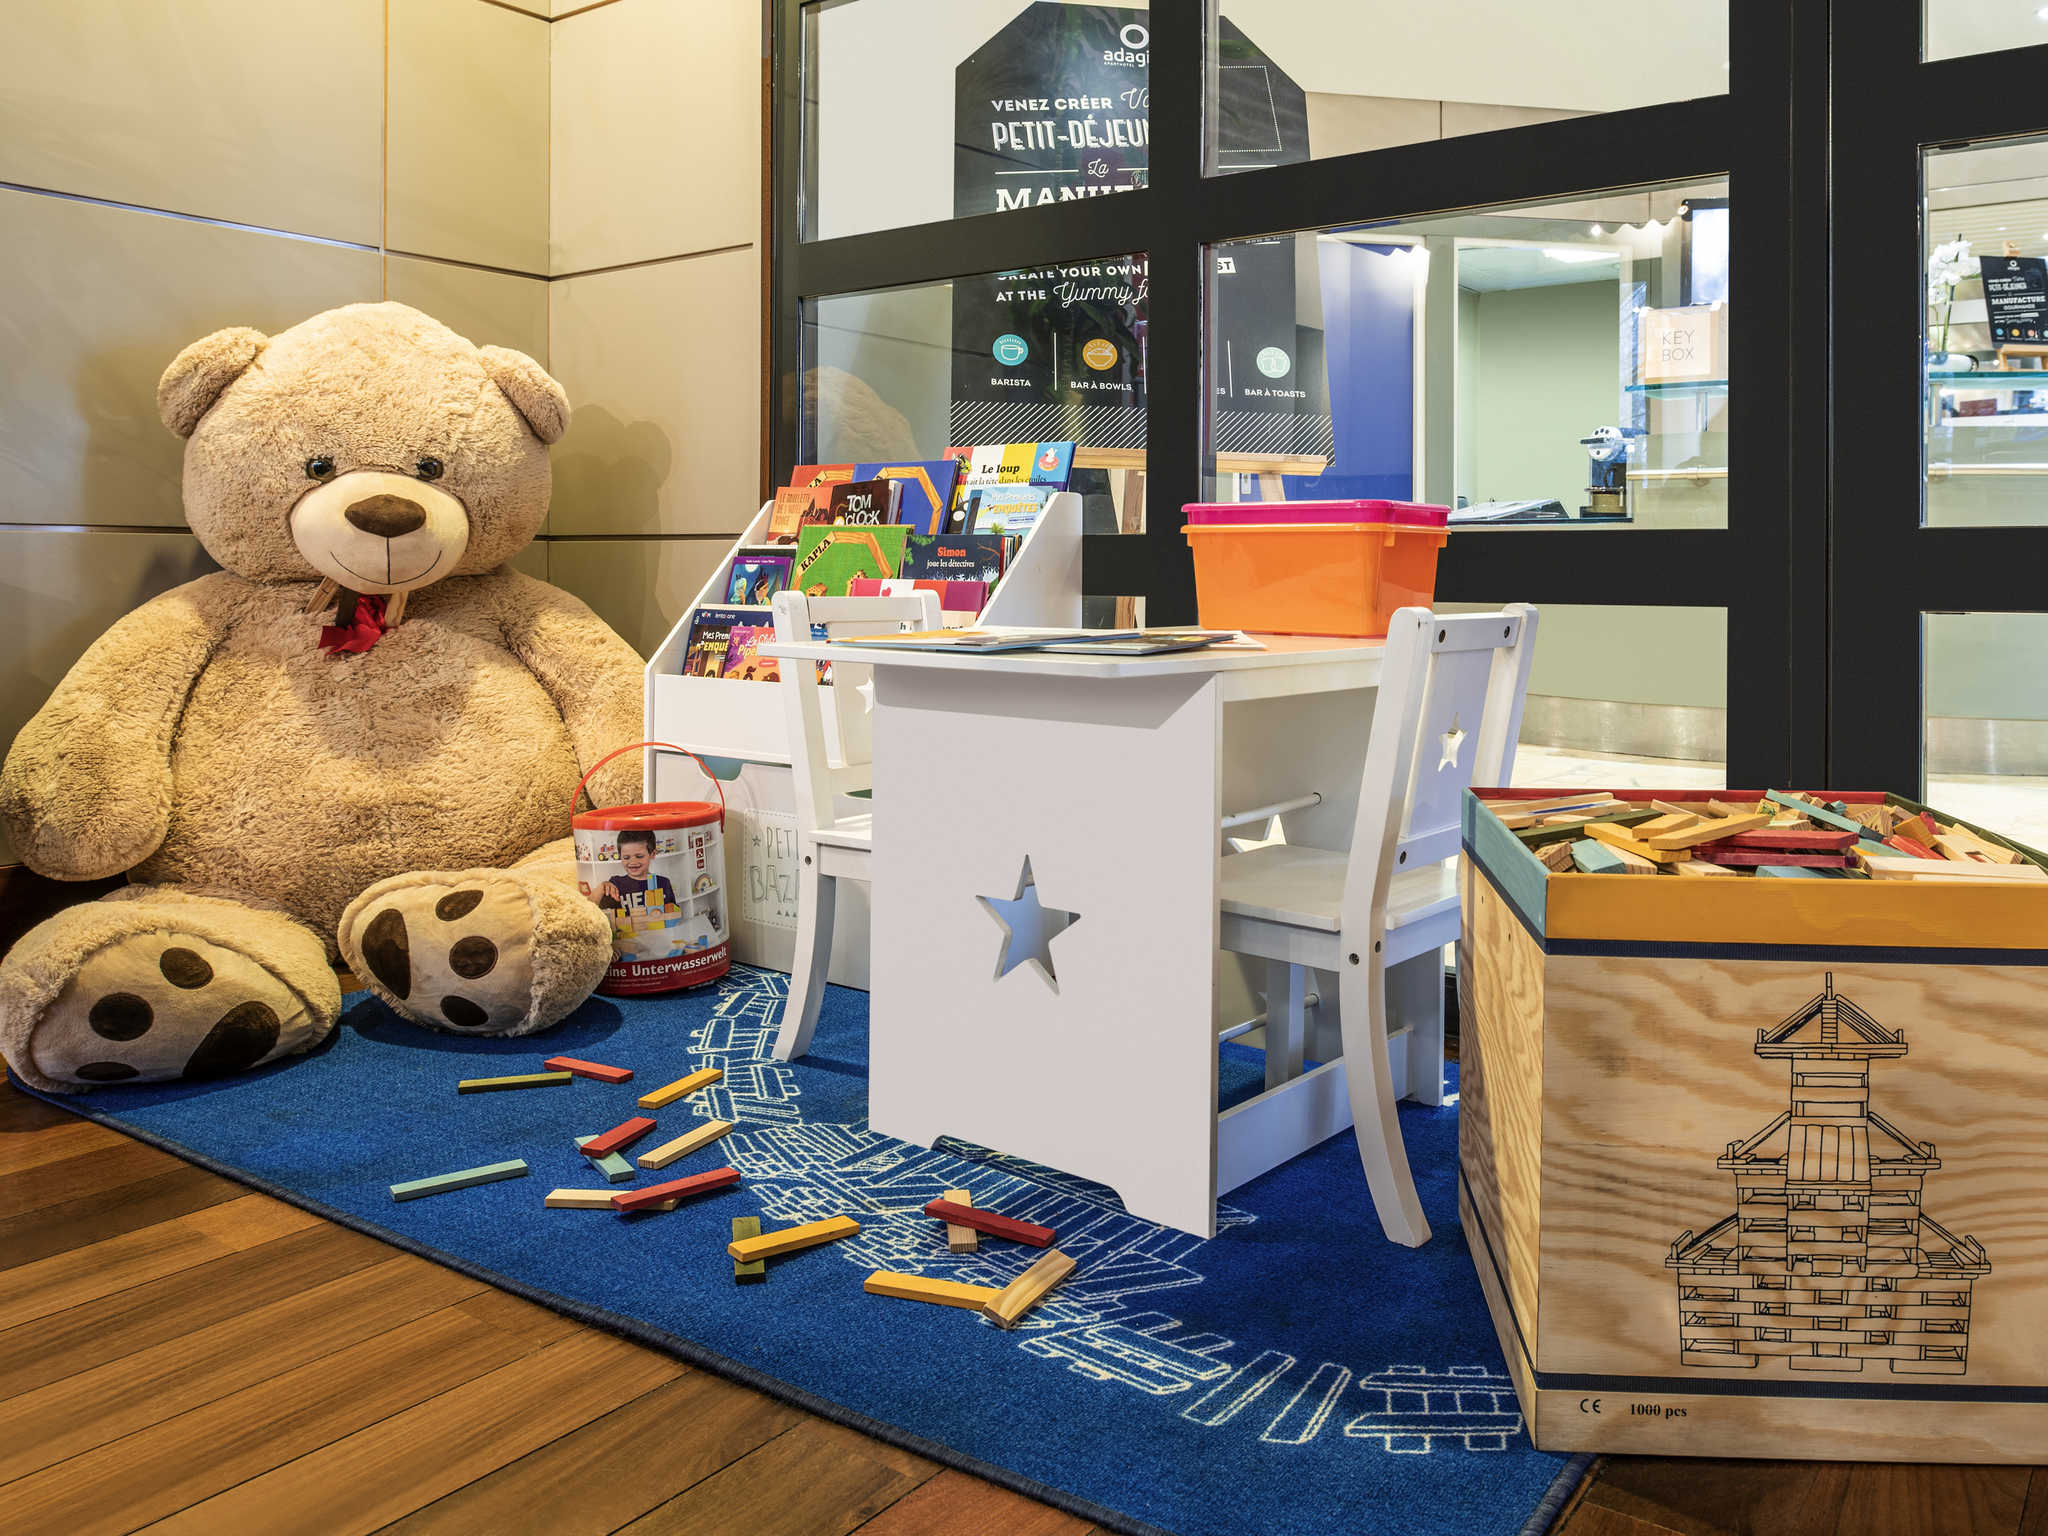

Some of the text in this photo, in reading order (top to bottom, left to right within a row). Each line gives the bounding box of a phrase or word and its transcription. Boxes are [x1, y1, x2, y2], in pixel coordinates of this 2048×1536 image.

[1104, 47, 1149, 67] adagi
[991, 99, 1049, 111] VENEZ
[1054, 95, 1113, 110] CRÉER
[1087, 158, 1109, 177] La
[1058, 266, 1101, 278] YOUR
[1106, 265, 1142, 276] OWN
[996, 291, 1014, 302] AT
[1017, 289, 1046, 300] THE
[1053, 281, 1133, 308] Yummy
[1992, 296, 2046, 305] MANUFACTURE
[1662, 329, 1695, 345] KEY
[1662, 347, 1694, 361] BOX
[991, 378, 1031, 387] BARISTA
[1070, 381, 1132, 391] BAR À BOWLS
[1244, 387, 1306, 398] BAR À TOASTS
[981, 464, 1020, 475] Le loup
[847, 494, 872, 512] TOM
[800, 538, 831, 571] KAPLA
[937, 546, 966, 557] Simon
[926, 559, 939, 569] joue
[948, 558, 975, 568] détectives
[737, 644, 758, 656] Pipe
[766, 826, 799, 860] PETI
[619, 891, 644, 910] HE
[631, 946, 727, 977] Unterwasserwelt
[1631, 1403, 1661, 1416] 1000
[1665, 1407, 1688, 1420] pcs
